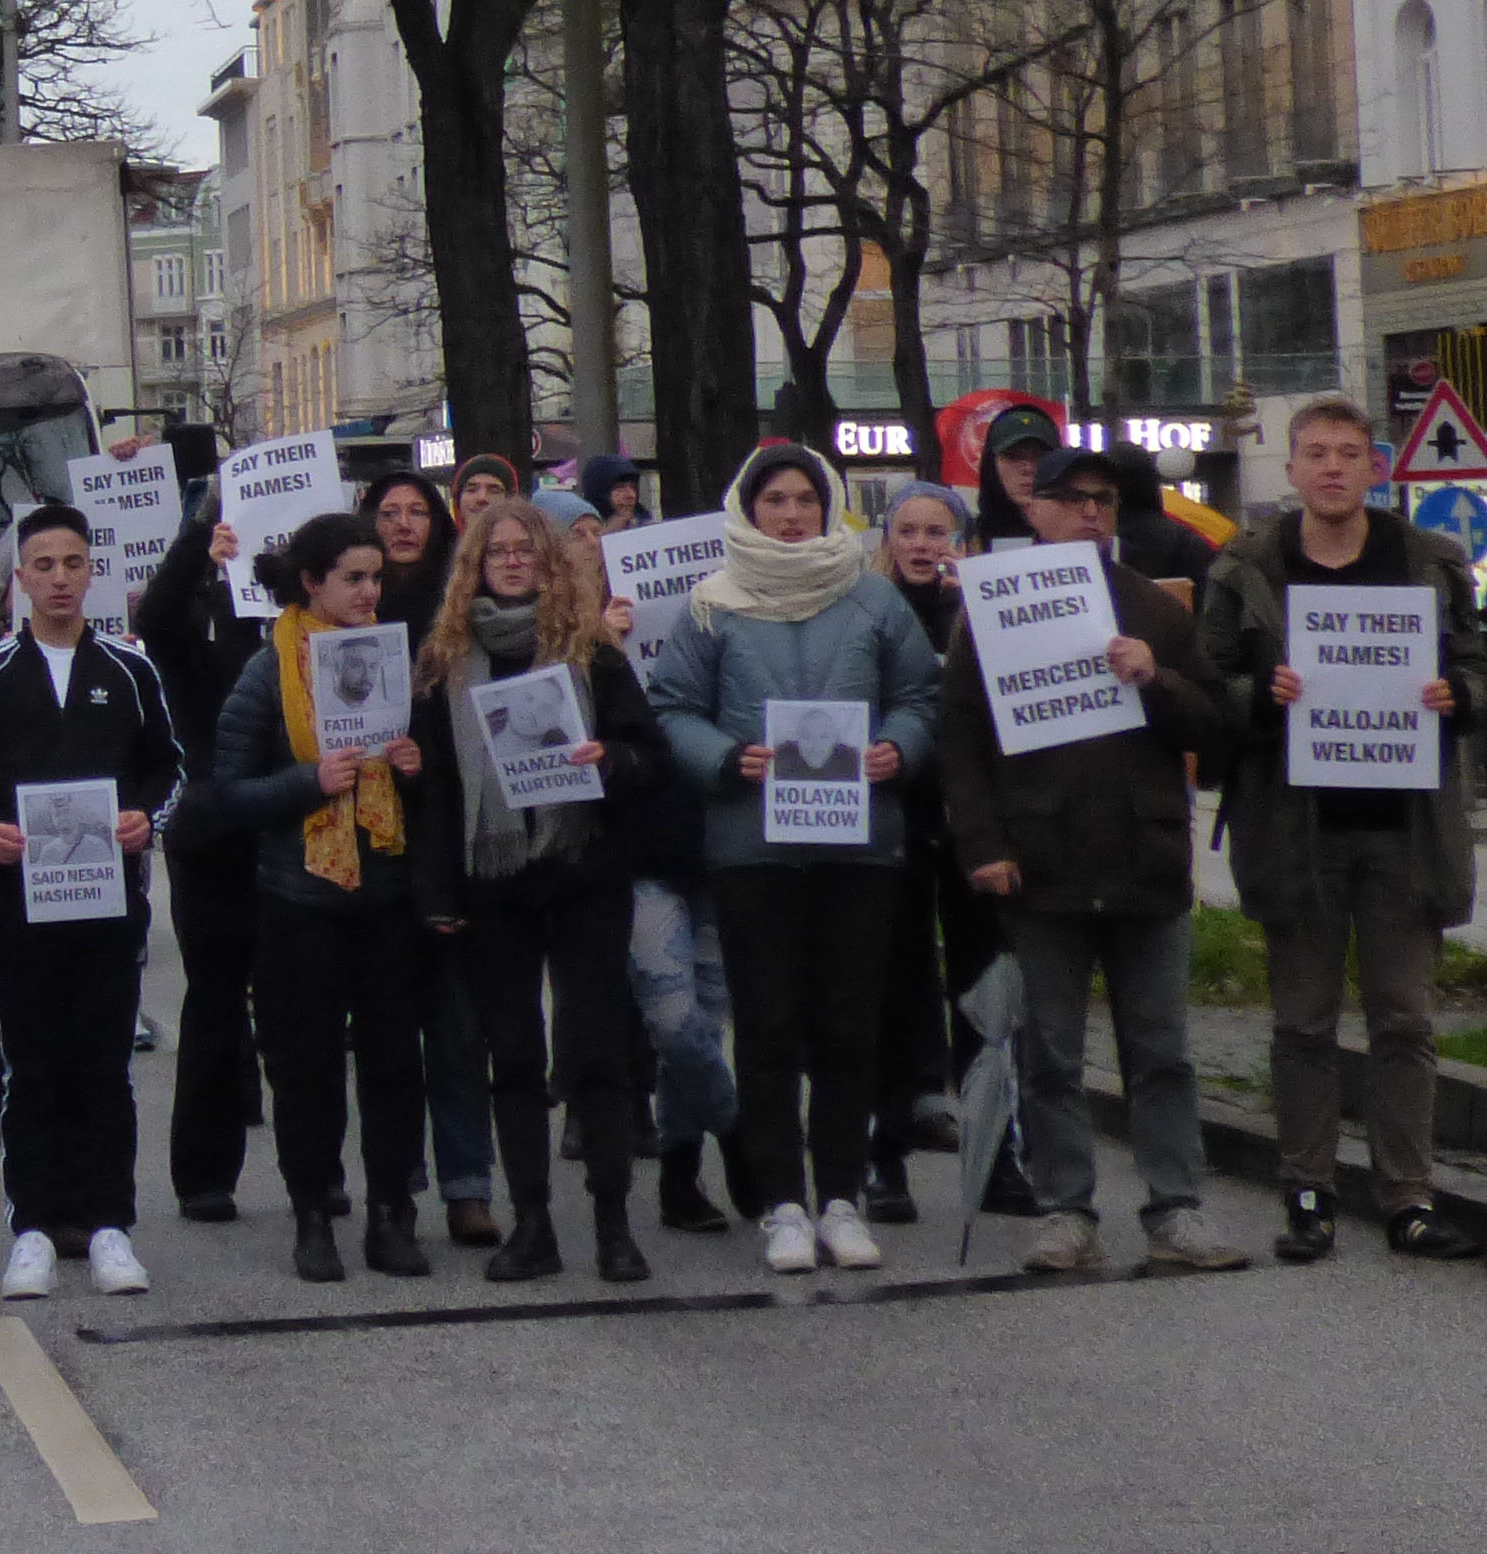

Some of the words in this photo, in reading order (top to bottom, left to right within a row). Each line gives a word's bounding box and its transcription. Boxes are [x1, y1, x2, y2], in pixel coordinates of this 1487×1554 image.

[231, 454, 259, 478] SAY
[264, 443, 318, 467] THEIR
[82, 474, 113, 493] SAY
[116, 466, 165, 487] THEIR
[239, 472, 312, 501] NAMES!
[124, 538, 166, 559] RHAT
[620, 550, 659, 575] SAY
[664, 538, 726, 566] THEIR
[636, 571, 709, 601] NAMES
[979, 575, 1021, 600] SAY
[1026, 566, 1093, 591] THEIR
[997, 596, 1089, 629] NAMES!
[1305, 611, 1349, 633] SAY
[1356, 613, 1423, 634] THEIR
[1318, 645, 1410, 666] NAMES!
[997, 655, 1108, 697] MERCEDE
[1012, 686, 1123, 726] KIERPACZ
[324, 716, 365, 732] FATIH
[1310, 708, 1419, 731] KALOJAN
[1312, 741, 1417, 764] WELKOW
[775, 787, 859, 806] KOLAYAN
[774, 809, 859, 828] WELKOW
[31, 871, 64, 886] SAID
[67, 866, 115, 882] NESAR
[33, 887, 102, 904] HASHEMI
